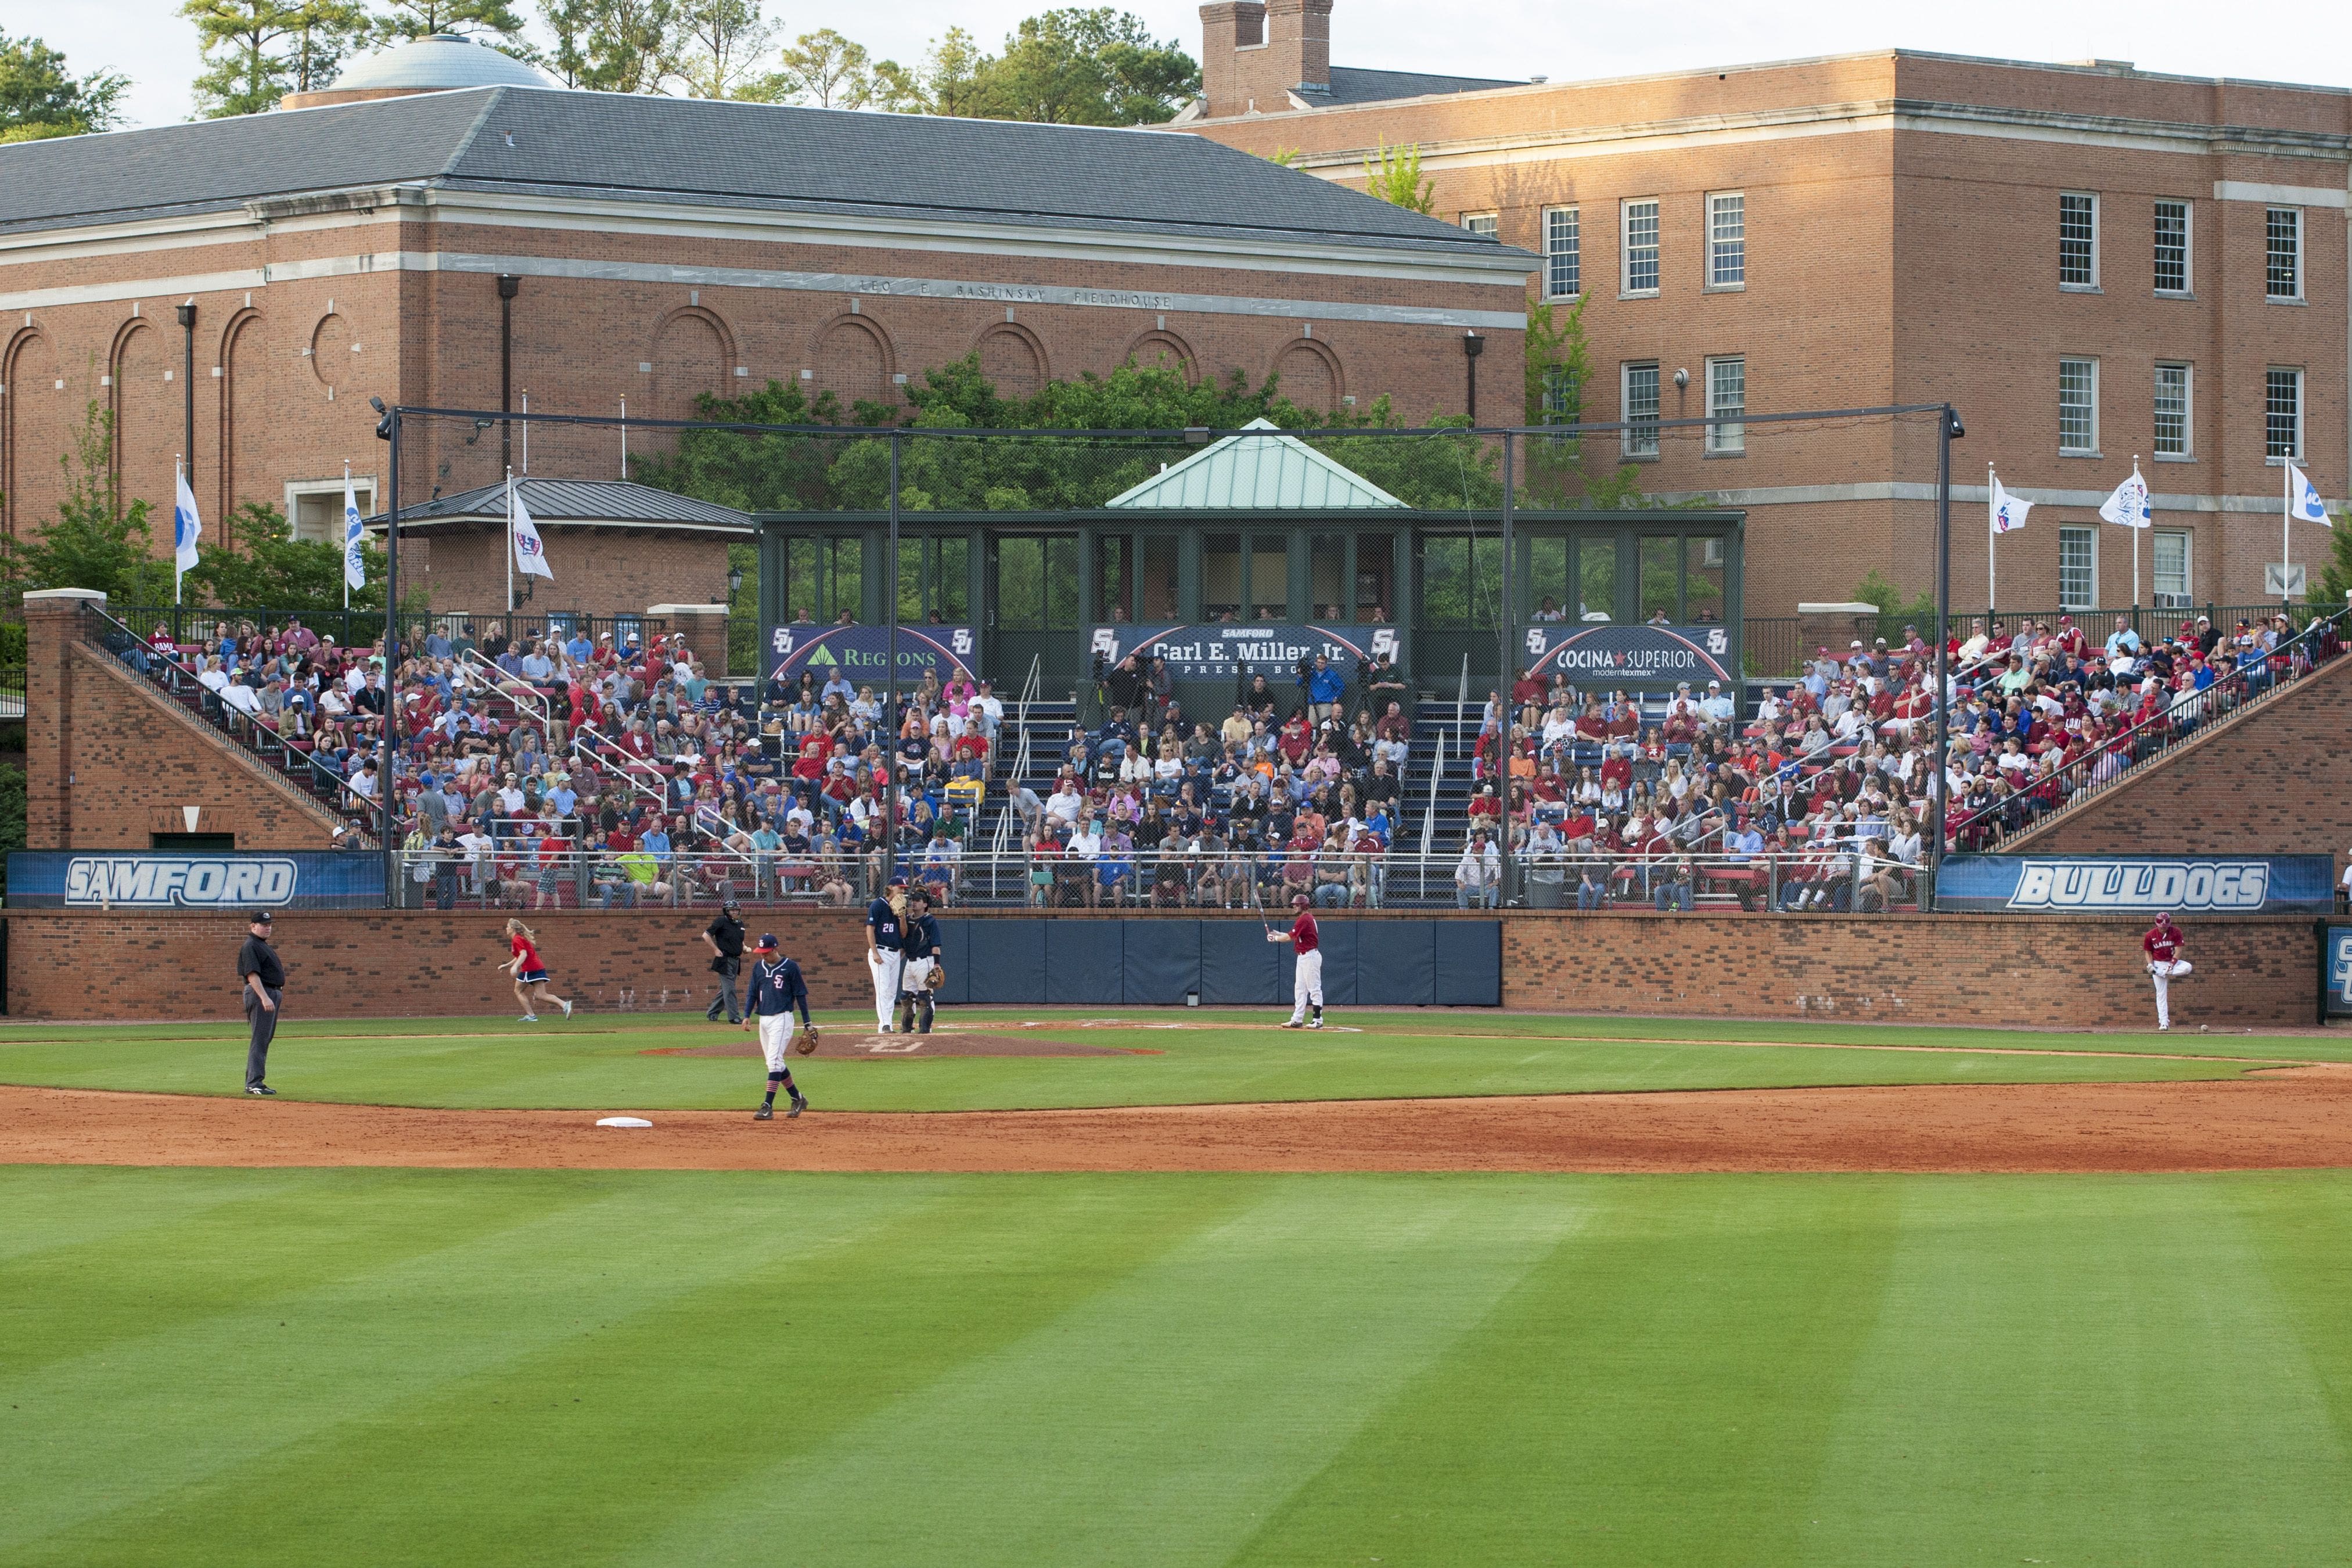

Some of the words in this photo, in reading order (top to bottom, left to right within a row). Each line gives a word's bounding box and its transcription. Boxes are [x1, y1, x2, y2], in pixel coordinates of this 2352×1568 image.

[860, 280, 890, 292] LEO
[956, 285, 1044, 300] BASHINSKY
[1074, 292, 1170, 308] FIELDHOUSE
[772, 628, 794, 654] SU
[952, 628, 973, 654] SU
[1221, 628, 1274, 638] SAMFORD
[1526, 628, 1547, 654] SU
[1706, 628, 1728, 655] SU
[844, 649, 936, 666] REGONS
[1153, 642, 1202, 661] Carl
[1209, 643, 1230, 661] E.
[1236, 642, 1310, 661] Miller
[1316, 643, 1344, 661] Jr.
[1557, 650, 1615, 668] COCINA
[1627, 650, 1696, 668] SUPERIOR
[1184, 666, 1254, 674] PRESS
[1274, 666, 1312, 674] BO
[66, 858, 297, 906] SAMFORD
[2006, 861, 2269, 910] BULLDOGS
[883, 923, 894, 933] 28
[774, 974, 784, 988] SU
